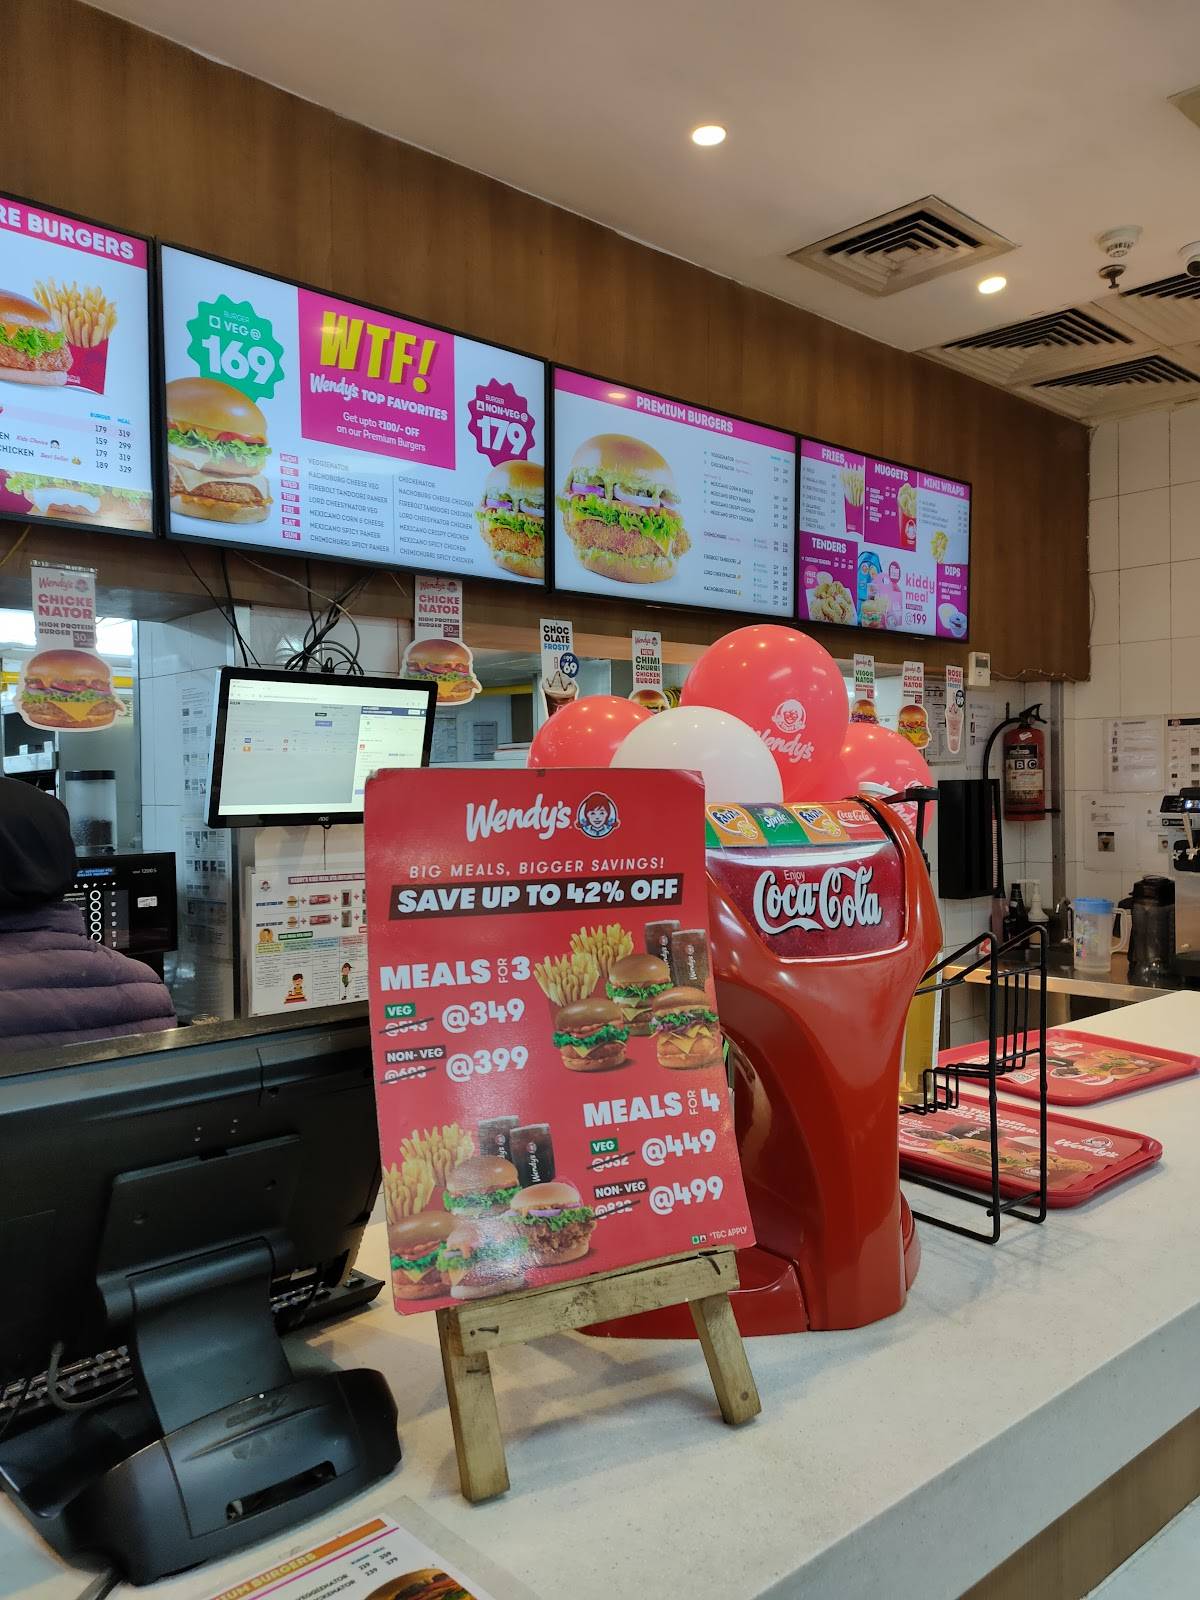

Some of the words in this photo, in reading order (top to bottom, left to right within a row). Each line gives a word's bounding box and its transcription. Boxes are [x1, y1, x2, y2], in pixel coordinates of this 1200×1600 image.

[28, 213, 134, 260] BURGERS
[223, 310, 250, 323] BURGER
[201, 334, 276, 385] 169
[319, 310, 436, 393] WTF!
[309, 372, 359, 401] Wendy's
[361, 388, 386, 405] TOP
[386, 396, 449, 421] FAVORITES
[485, 394, 505, 405] BURGER
[636, 395, 686, 422] PREMIUM
[687, 409, 734, 434] BURGERS
[95, 424, 108, 434] 179
[118, 429, 131, 438] 319
[342, 411, 359, 424] Get
[359, 415, 377, 430] upto
[404, 426, 420, 438] OFF
[95, 437, 108, 446] 159
[118, 441, 131, 450] 299
[336, 425, 348, 434] on
[348, 428, 362, 437] our
[363, 430, 397, 446] Premium
[397, 437, 426, 453] Burgers
[476, 415, 527, 456] 179
[95, 449, 108, 458] 179
[119, 453, 131, 462] 319
[821, 447, 845, 464] FRIES
[95, 461, 109, 470] 189
[119, 465, 132, 473] 329
[874, 463, 909, 482] NUGGETS
[923, 476, 941, 491] MINI
[941, 482, 965, 497] WRAPS
[811, 537, 847, 555] TENDERS
[944, 565, 961, 578] DIPS
[38, 577, 74, 592] Wendy's
[905, 571, 935, 594] kiddy
[38, 593, 93, 608] CHICKE
[418, 594, 460, 605] CHICKE
[905, 590, 929, 604] meal
[38, 605, 93, 620] NATOR
[418, 603, 460, 615] NATOR
[38, 621, 59, 629] HIGH
[60, 622, 94, 631] PROTEIN
[38, 628, 72, 637] BURGER
[543, 625, 570, 635] CHOC
[543, 633, 570, 644] OLATE
[543, 643, 570, 652] FROSTY
[635, 656, 660, 665] CHIMI
[635, 664, 661, 672] CHURRI
[635, 677, 661, 685] BURGER
[855, 676, 874, 685] NATOR
[947, 668, 962, 678] ROSE
[903, 681, 923, 690] NATOR
[1016, 760, 1024, 769] B
[1028, 760, 1037, 769] C
[466, 793, 573, 842] Wendy's
[712, 809, 741, 826] Fanta
[763, 813, 788, 829] Sprite
[799, 808, 825, 824] Fanta
[836, 809, 871, 823] Coca-Cola
[409, 865, 443, 879] BIG
[449, 862, 511, 878] MEALS,
[518, 859, 584, 876] BIGGER
[590, 856, 666, 873] SAVINGS!
[783, 869, 806, 884] Enjoy
[397, 886, 476, 914] SAVE
[481, 885, 521, 909] UP
[525, 882, 562, 907] TO
[566, 879, 625, 904] 42%
[630, 878, 679, 901] OFF
[753, 865, 883, 935] Coca-Cola
[379, 958, 492, 992] MEALS
[497, 957, 509, 984] FOR
[511, 955, 531, 982] 3
[386, 1005, 413, 1017] VEG
[441, 997, 526, 1034] @349
[386, 1050, 418, 1063] NON-
[419, 1047, 444, 1059] VEG
[445, 1045, 529, 1083] @399
[582, 1091, 684, 1128] MEALS
[687, 1090, 699, 1116] FOR
[700, 1087, 721, 1112] 4
[591, 1140, 616, 1152] VEG
[641, 1128, 717, 1167] @449
[1054, 1138, 1120, 1160] Wendy's
[528, 1154, 542, 1183] Wendy's
[595, 1186, 624, 1199] NON-
[623, 1180, 647, 1193] VEG
[649, 1175, 724, 1216] @499
[727, 1225, 748, 1237] APPLY
[250, 1552, 317, 1588] BURGERS
